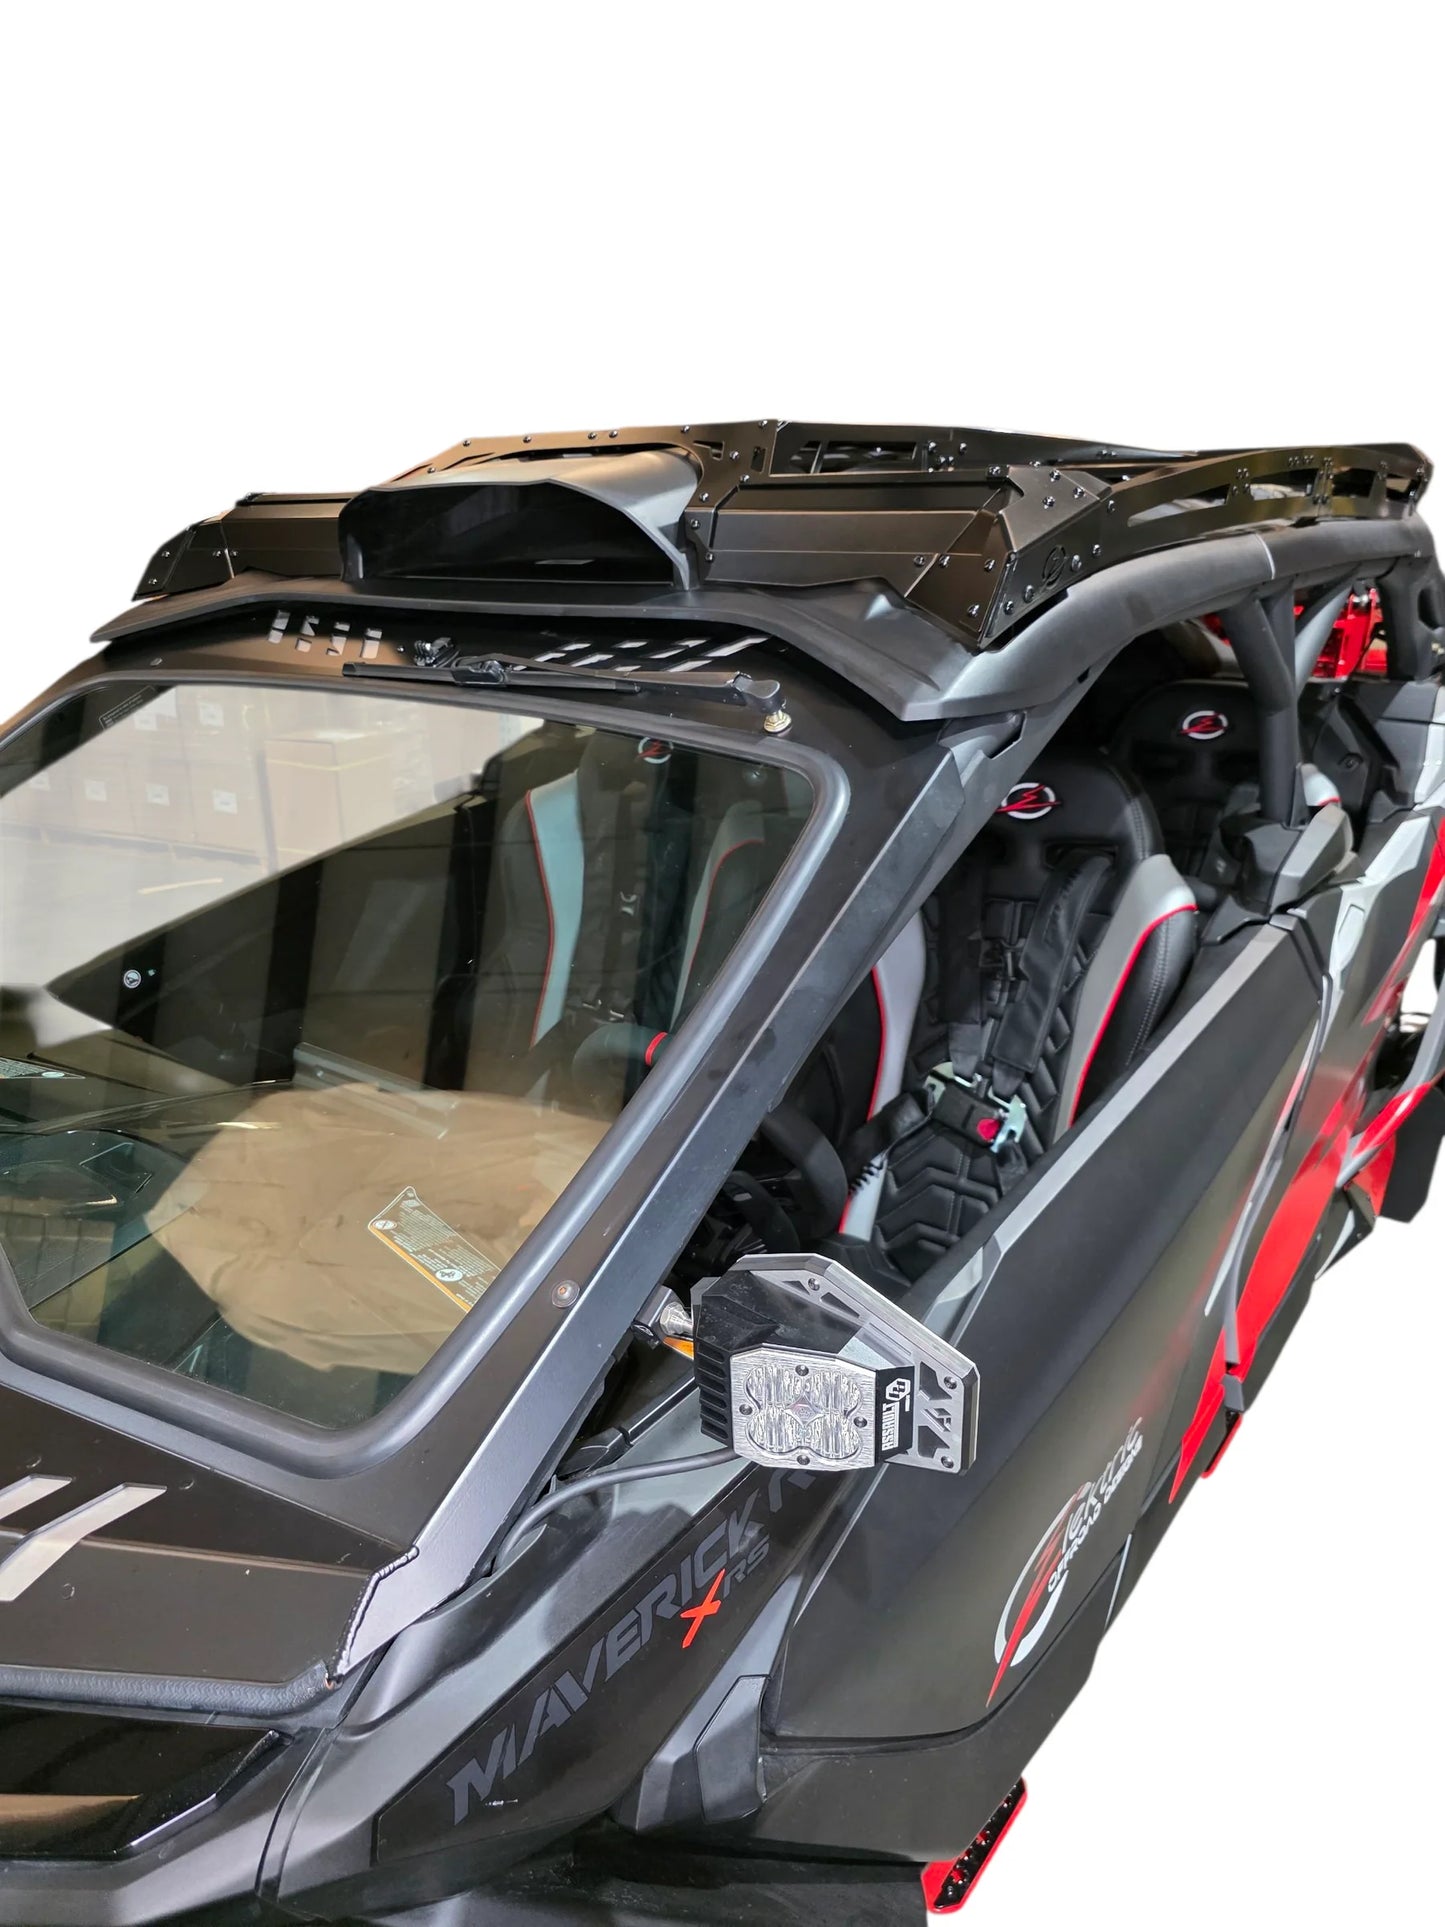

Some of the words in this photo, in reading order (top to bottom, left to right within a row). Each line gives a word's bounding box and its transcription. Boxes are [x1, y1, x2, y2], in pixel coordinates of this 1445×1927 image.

[882, 1402, 895, 1451] ASSAULT
[1048, 1502, 1102, 1593] OFFROAD
[446, 1488, 766, 1826] MAVERICK
